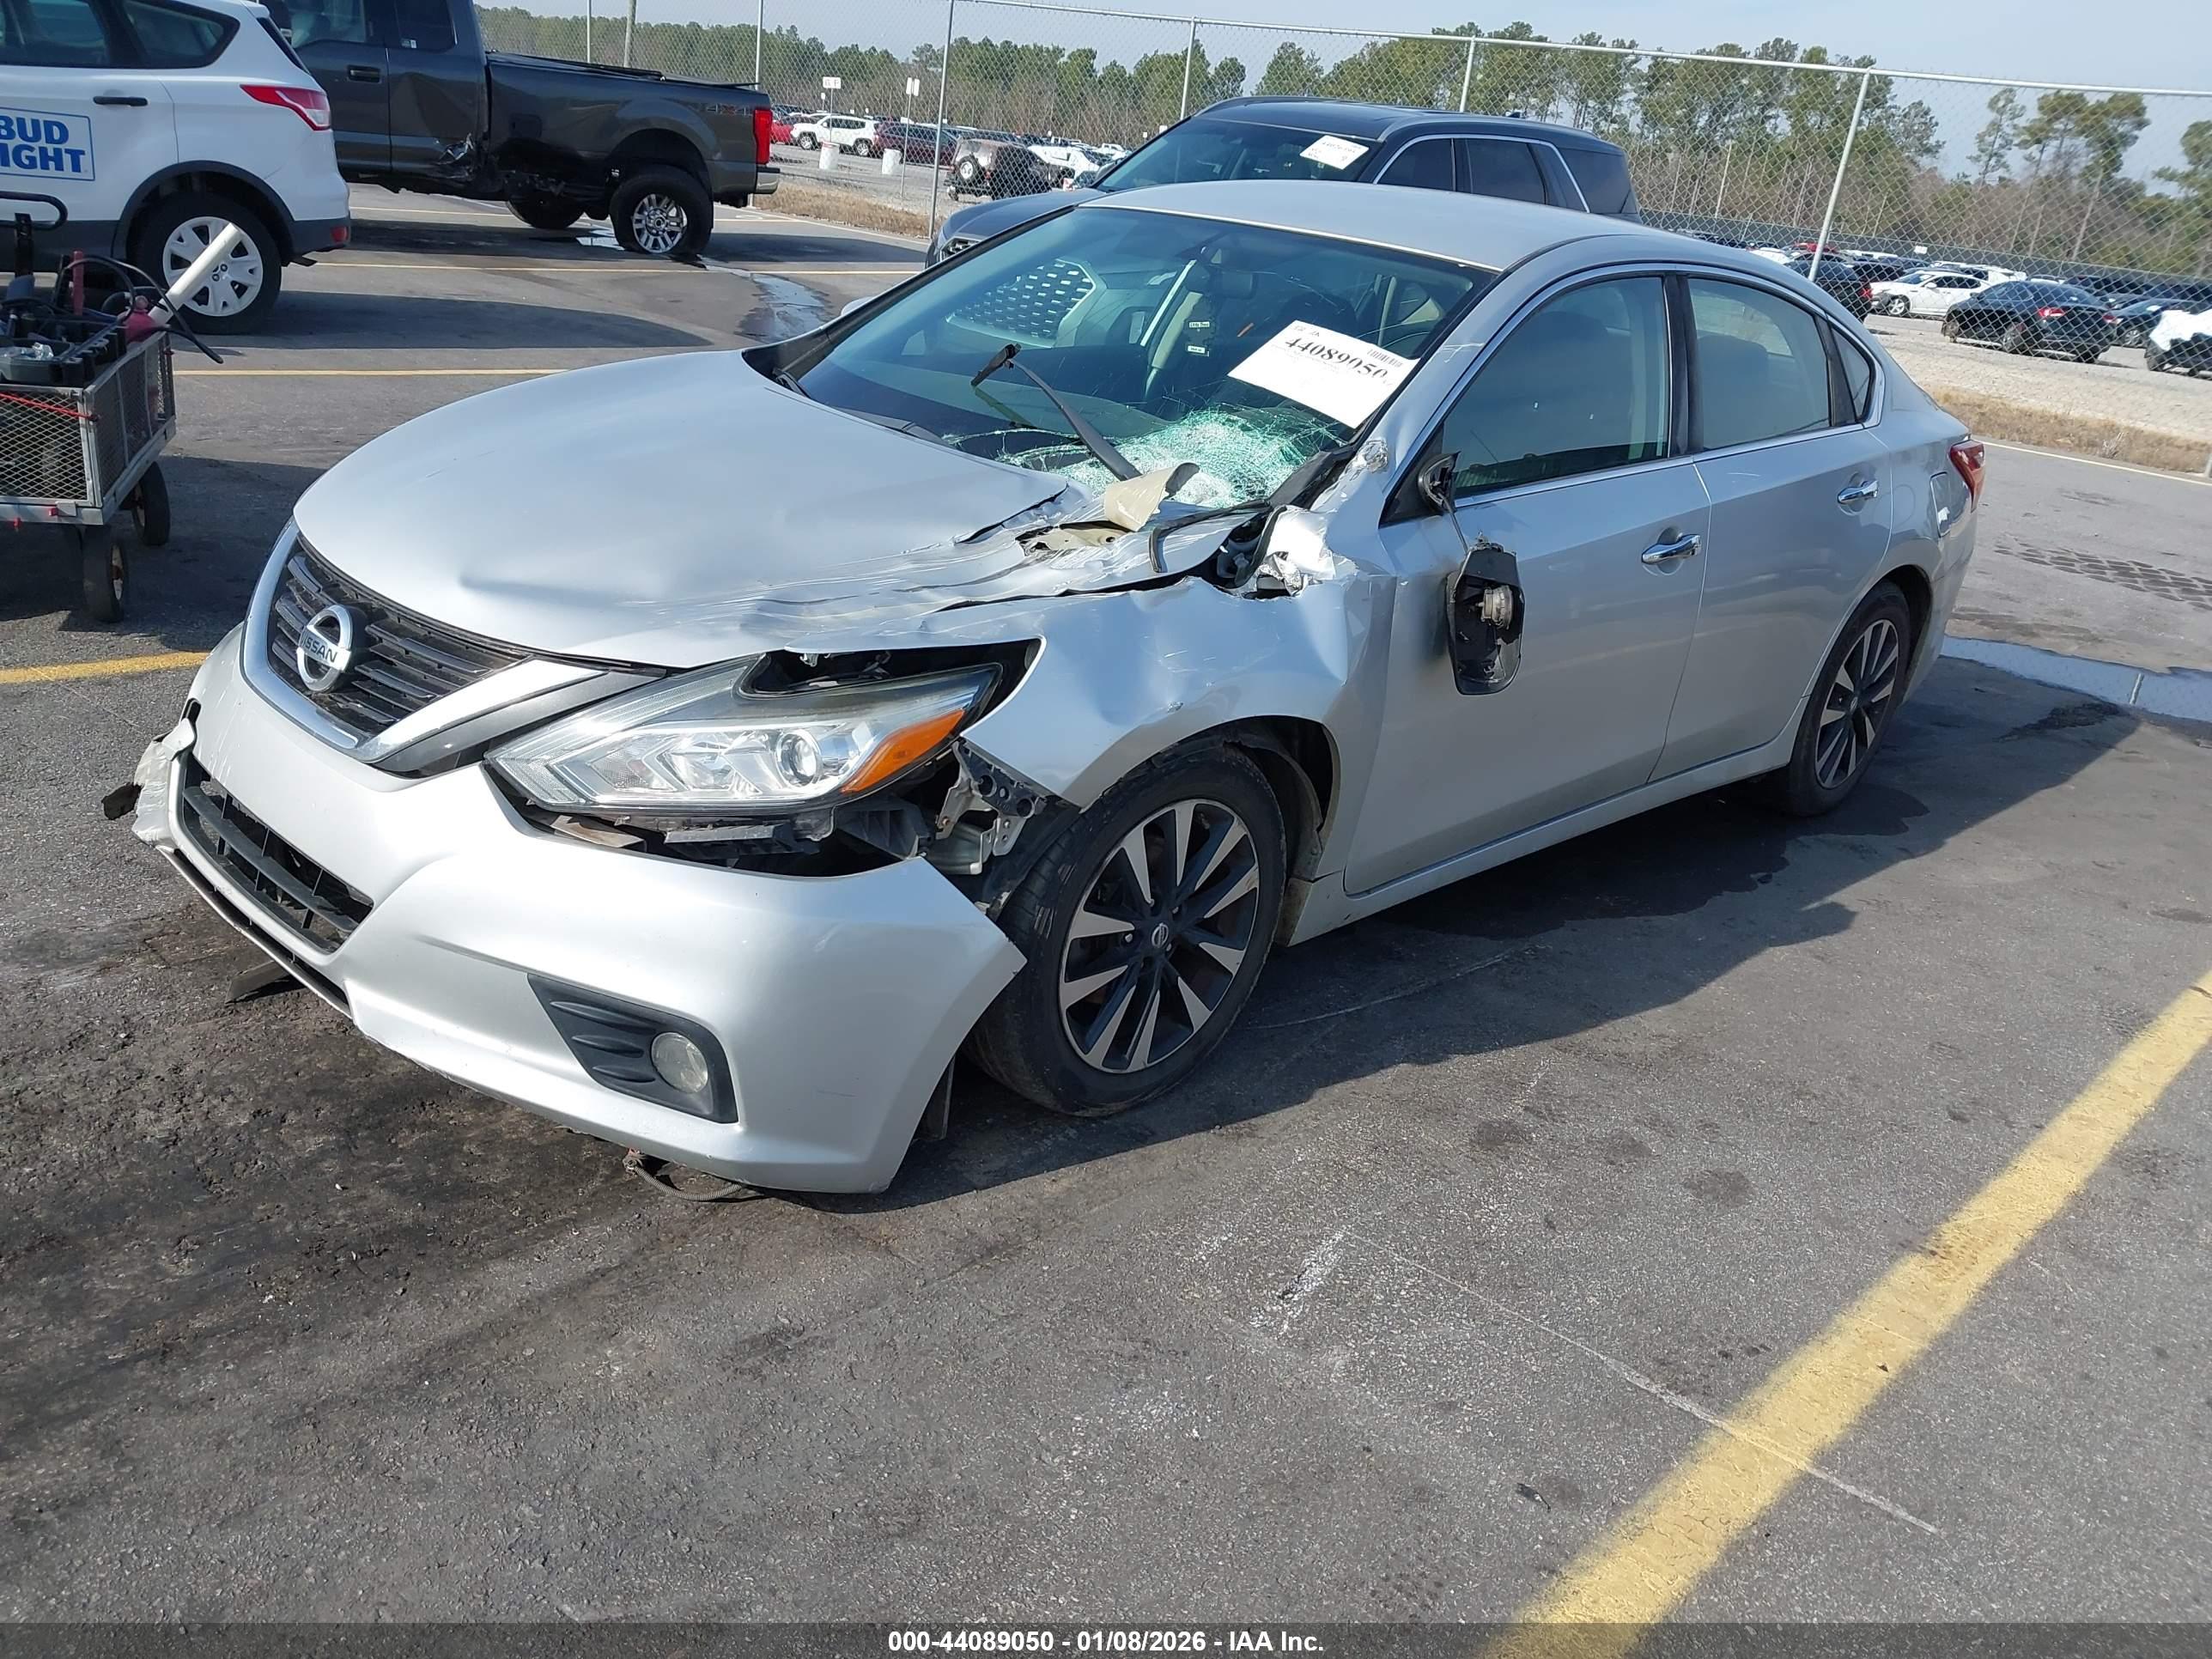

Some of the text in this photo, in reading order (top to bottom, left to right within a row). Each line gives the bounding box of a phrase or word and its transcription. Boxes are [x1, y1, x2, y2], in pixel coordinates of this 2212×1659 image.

[0, 115, 69, 144] BUD
[0, 143, 85, 173] IGHT
[1285, 337, 1388, 379] 44089050
